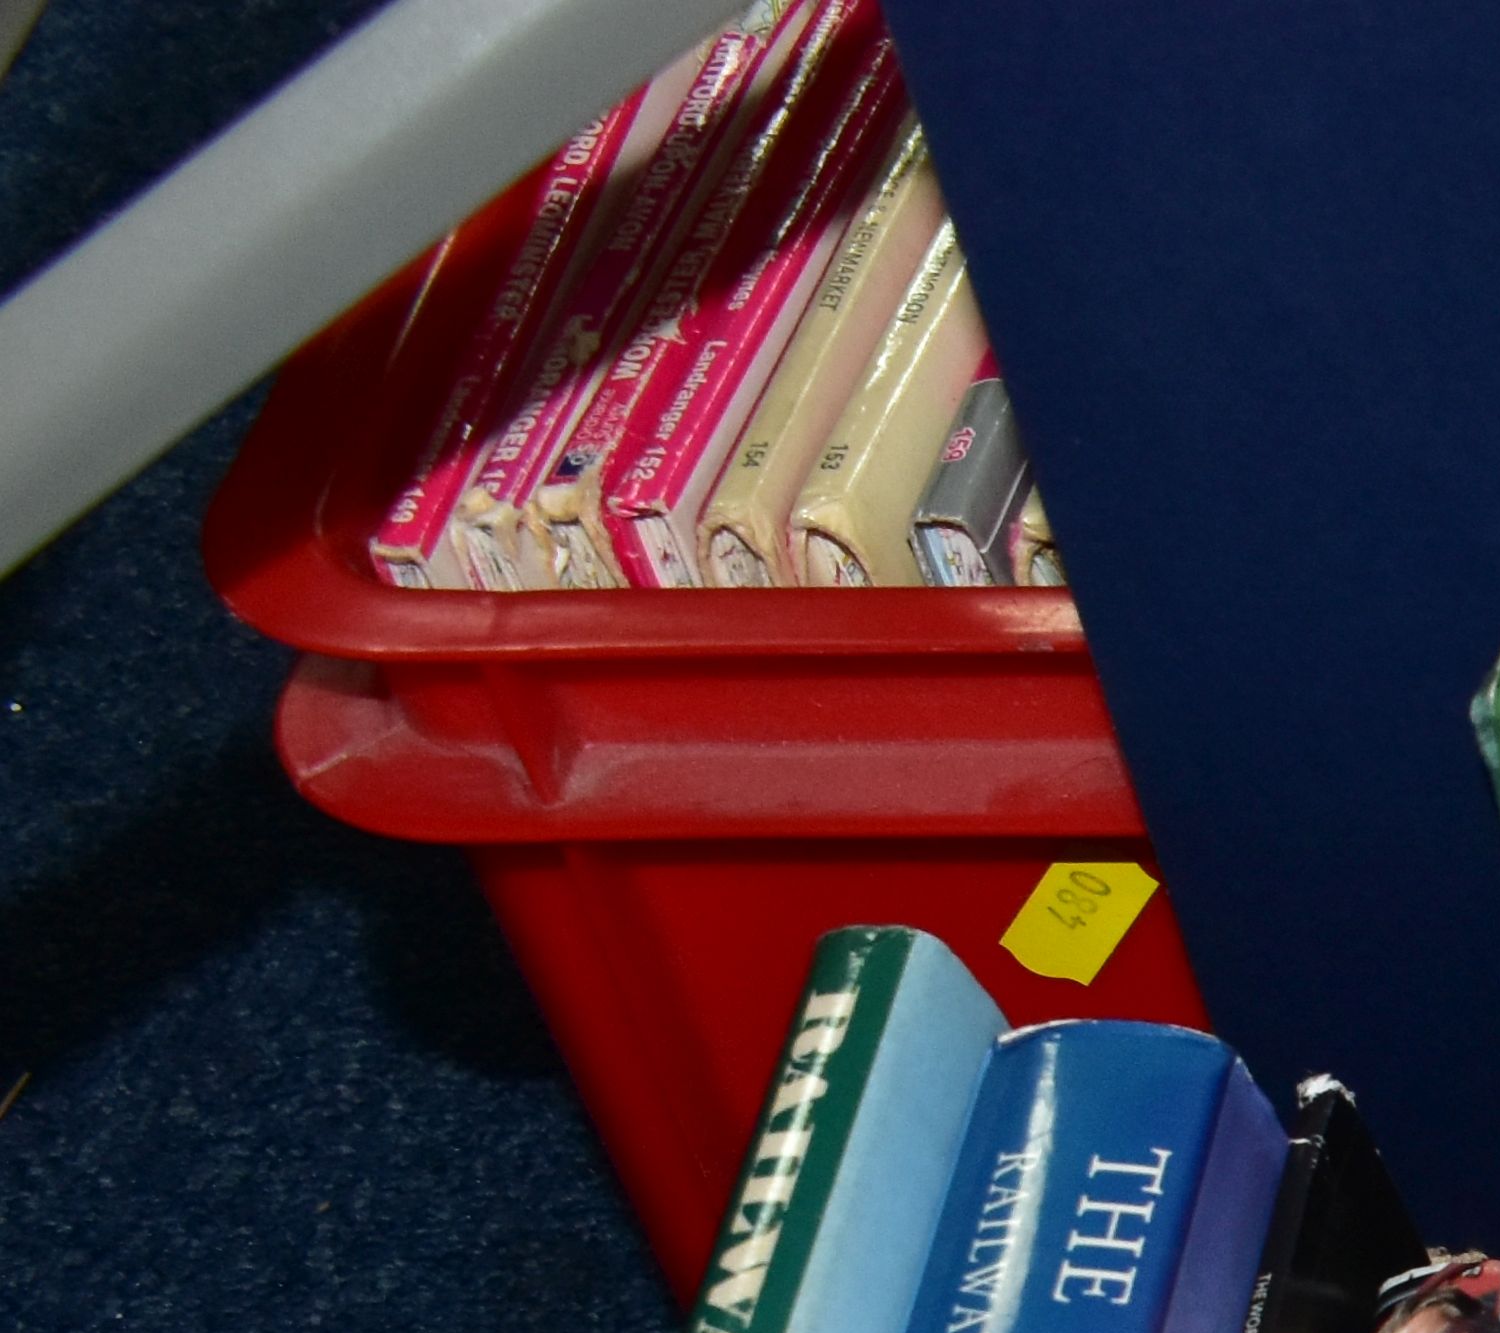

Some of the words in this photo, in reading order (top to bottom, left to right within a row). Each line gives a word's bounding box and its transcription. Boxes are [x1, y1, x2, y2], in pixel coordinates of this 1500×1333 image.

[656, 339, 729, 442] Landranger
[629, 448, 666, 482] 152
[741, 441, 769, 469] 154
[820, 444, 849, 472] 153
[390, 487, 429, 525] 149
[1047, 869, 1112, 930] 480
[1052, 1147, 1172, 1305] THE
[1253, 1272, 1272, 1300] THE
